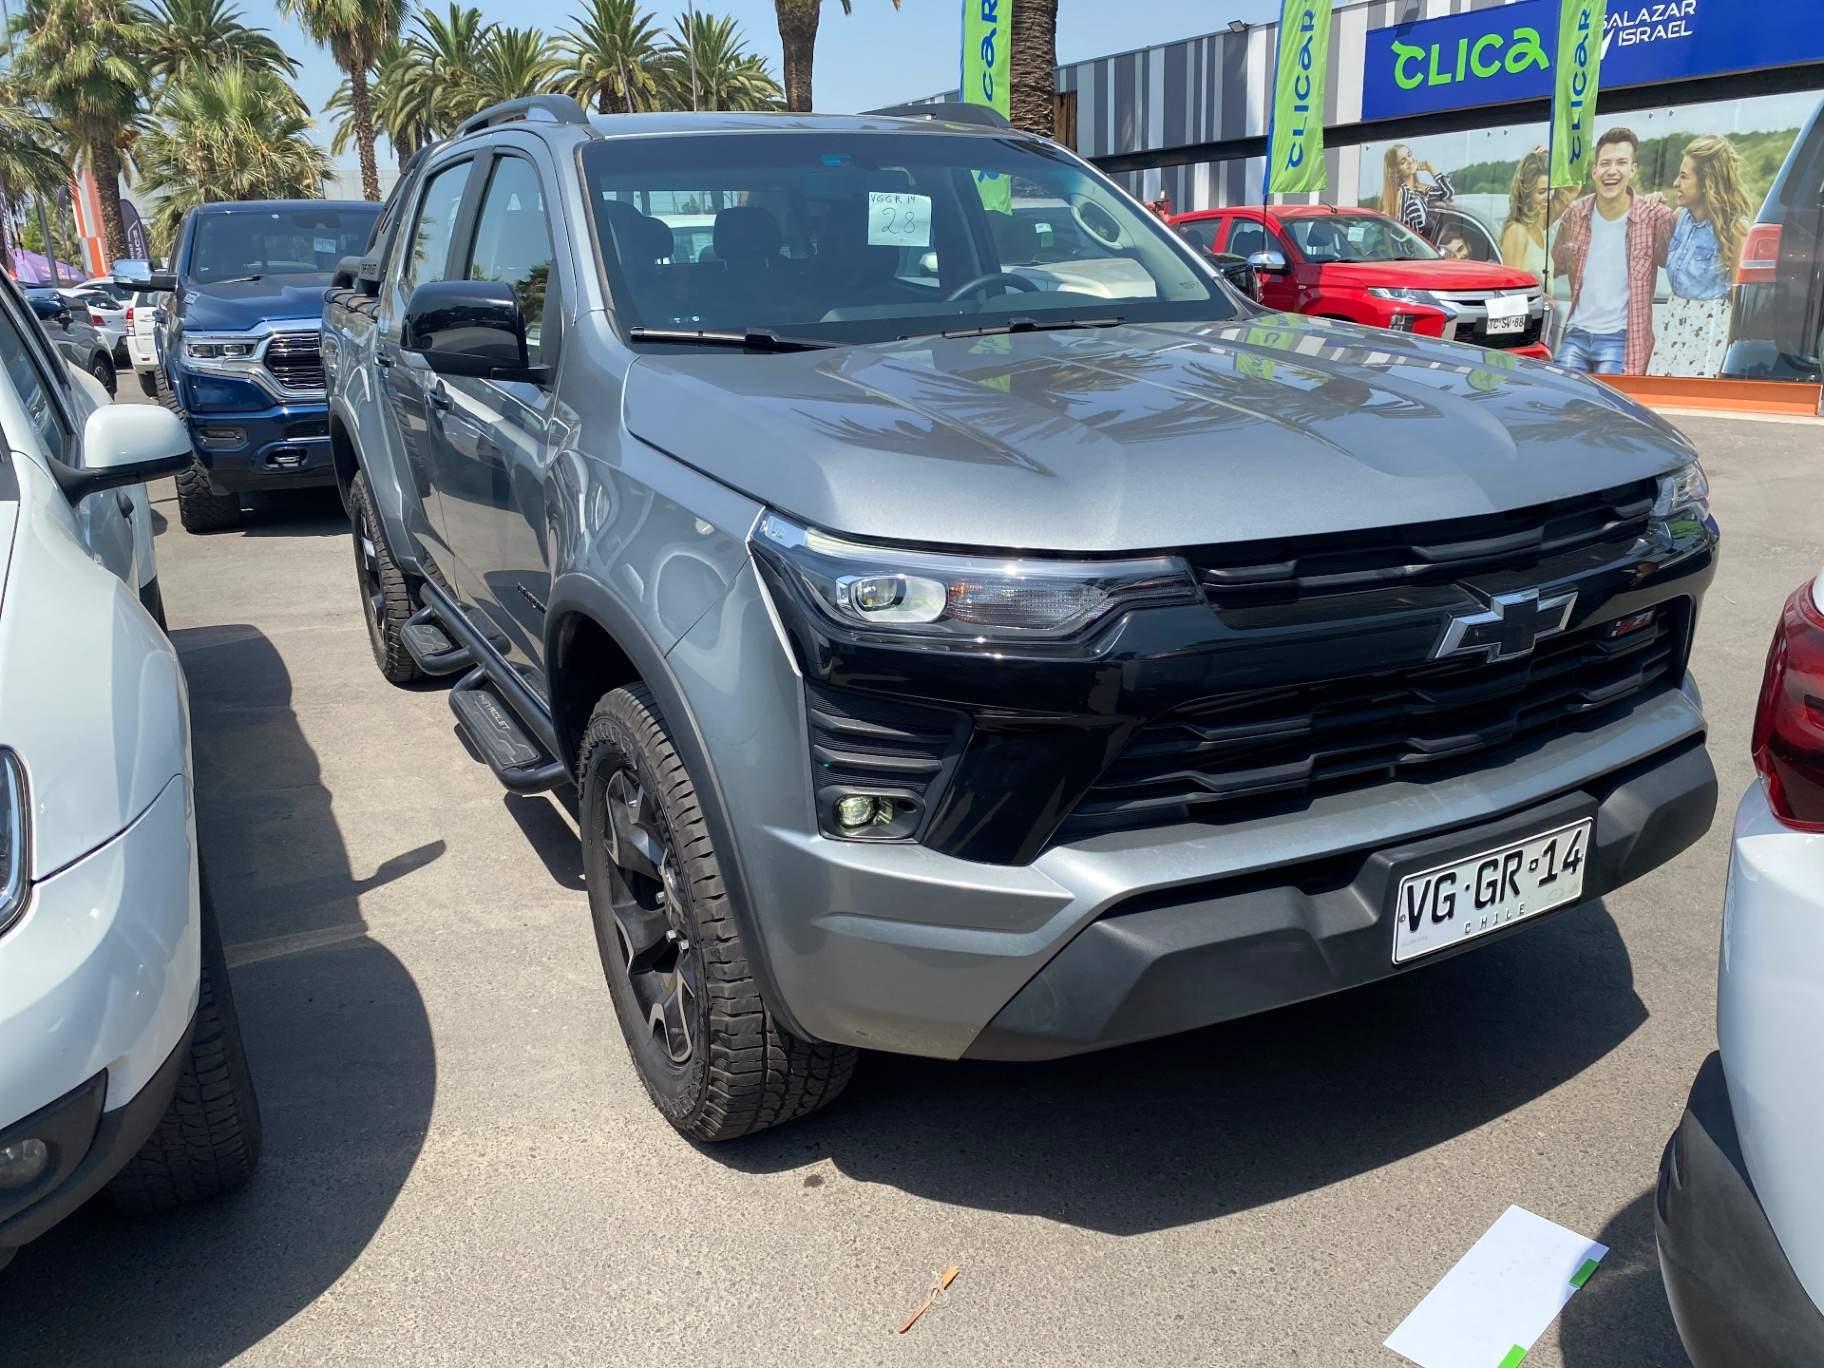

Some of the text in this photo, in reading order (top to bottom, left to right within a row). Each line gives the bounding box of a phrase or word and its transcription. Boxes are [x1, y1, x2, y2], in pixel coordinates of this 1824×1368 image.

[1618, 20, 1694, 47] ISRAEL
[880, 207, 916, 235] 28
[1463, 903, 1526, 935] CHILE
